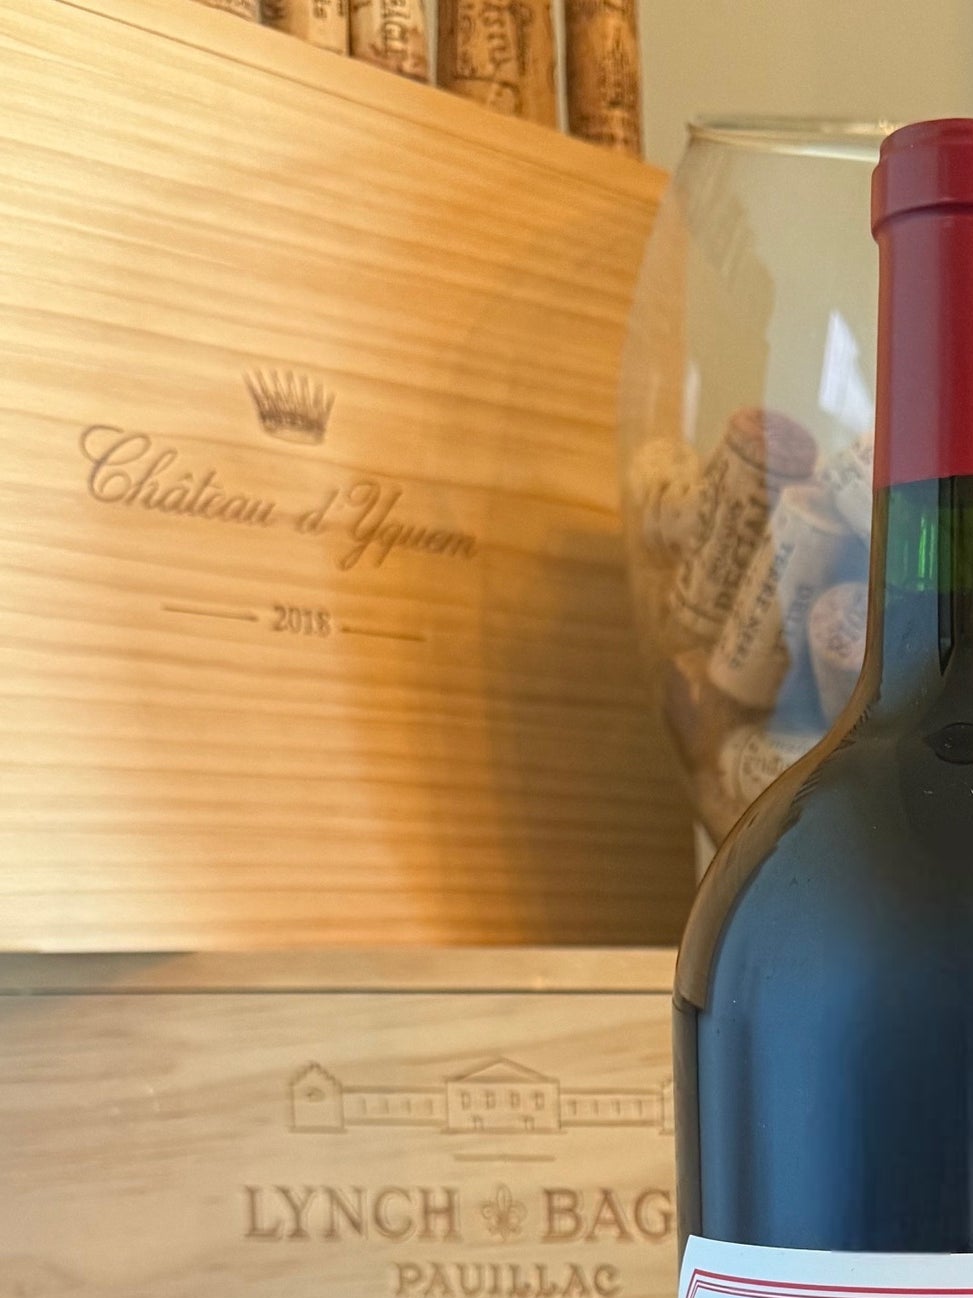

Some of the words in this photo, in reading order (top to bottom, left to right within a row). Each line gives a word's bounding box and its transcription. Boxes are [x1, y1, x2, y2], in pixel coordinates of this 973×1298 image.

[79, 424, 277, 528] Château
[270, 603, 331, 638] 2018
[243, 1184, 461, 1242] LYNCH
[540, 1187, 674, 1244] BAG
[393, 1262, 622, 1298] PAUILLAC
